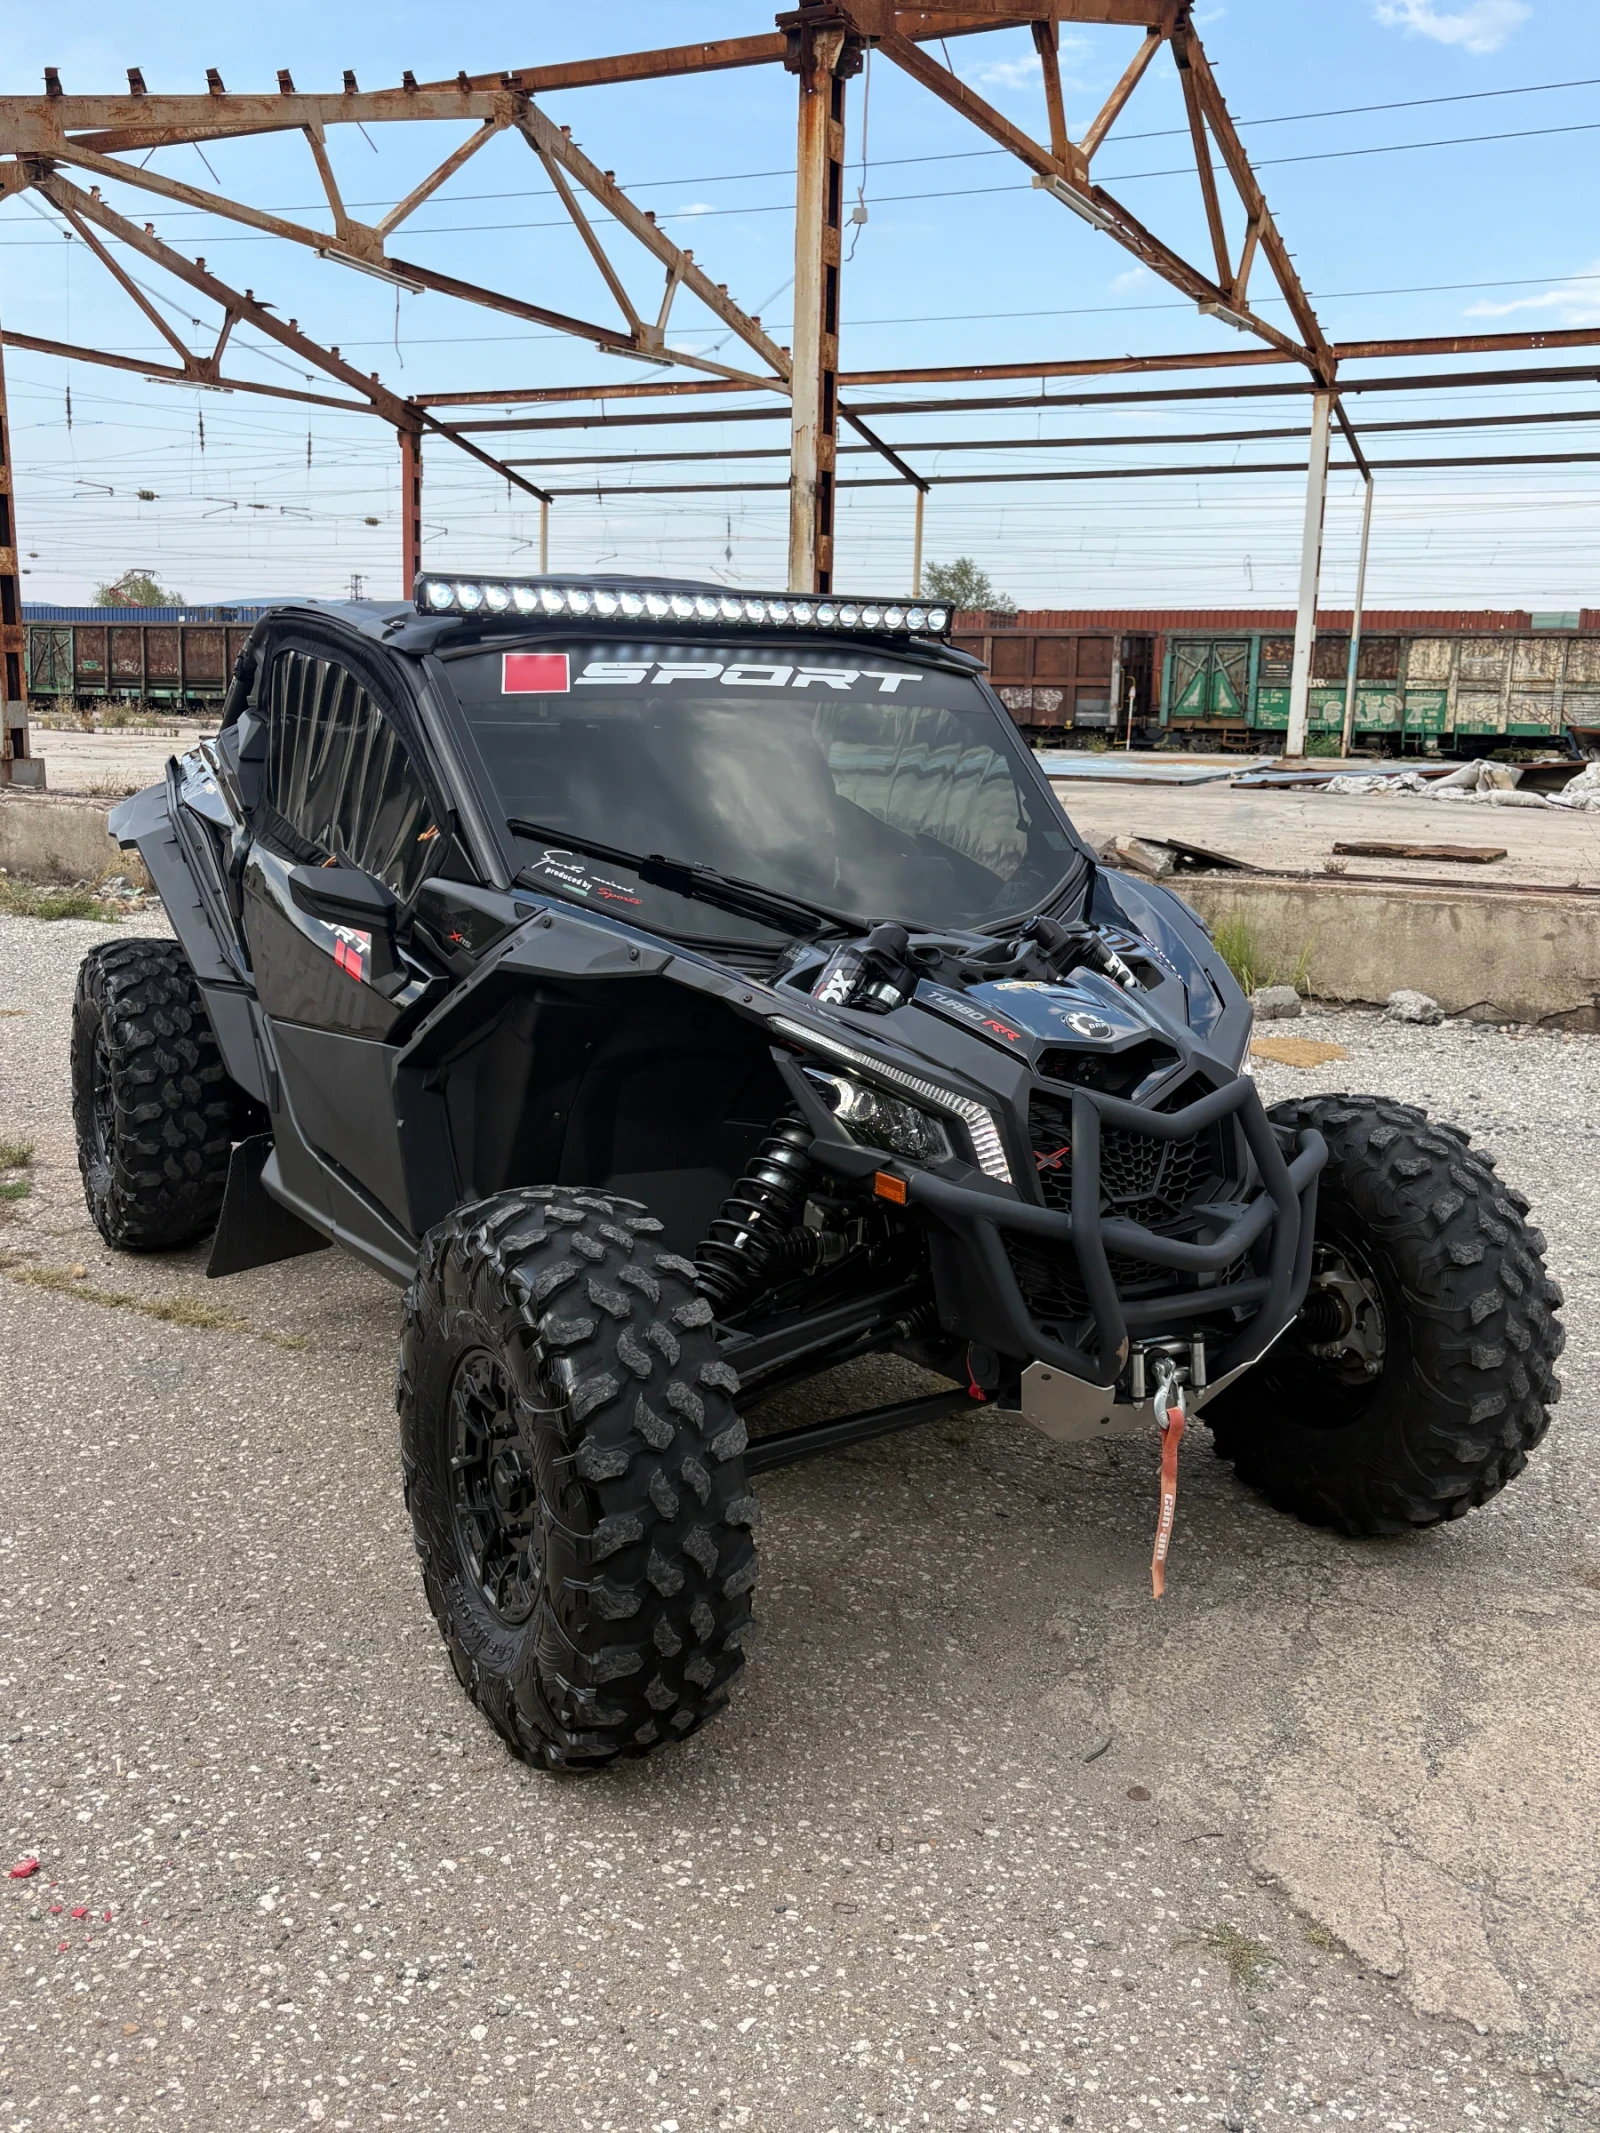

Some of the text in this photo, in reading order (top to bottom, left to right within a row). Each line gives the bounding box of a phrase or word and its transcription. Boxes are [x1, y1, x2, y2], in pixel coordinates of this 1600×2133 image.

[574, 662, 923, 693] SPORT
[927, 991, 1021, 1041] TURBO RR
[1156, 1493, 1173, 1561] can-am
